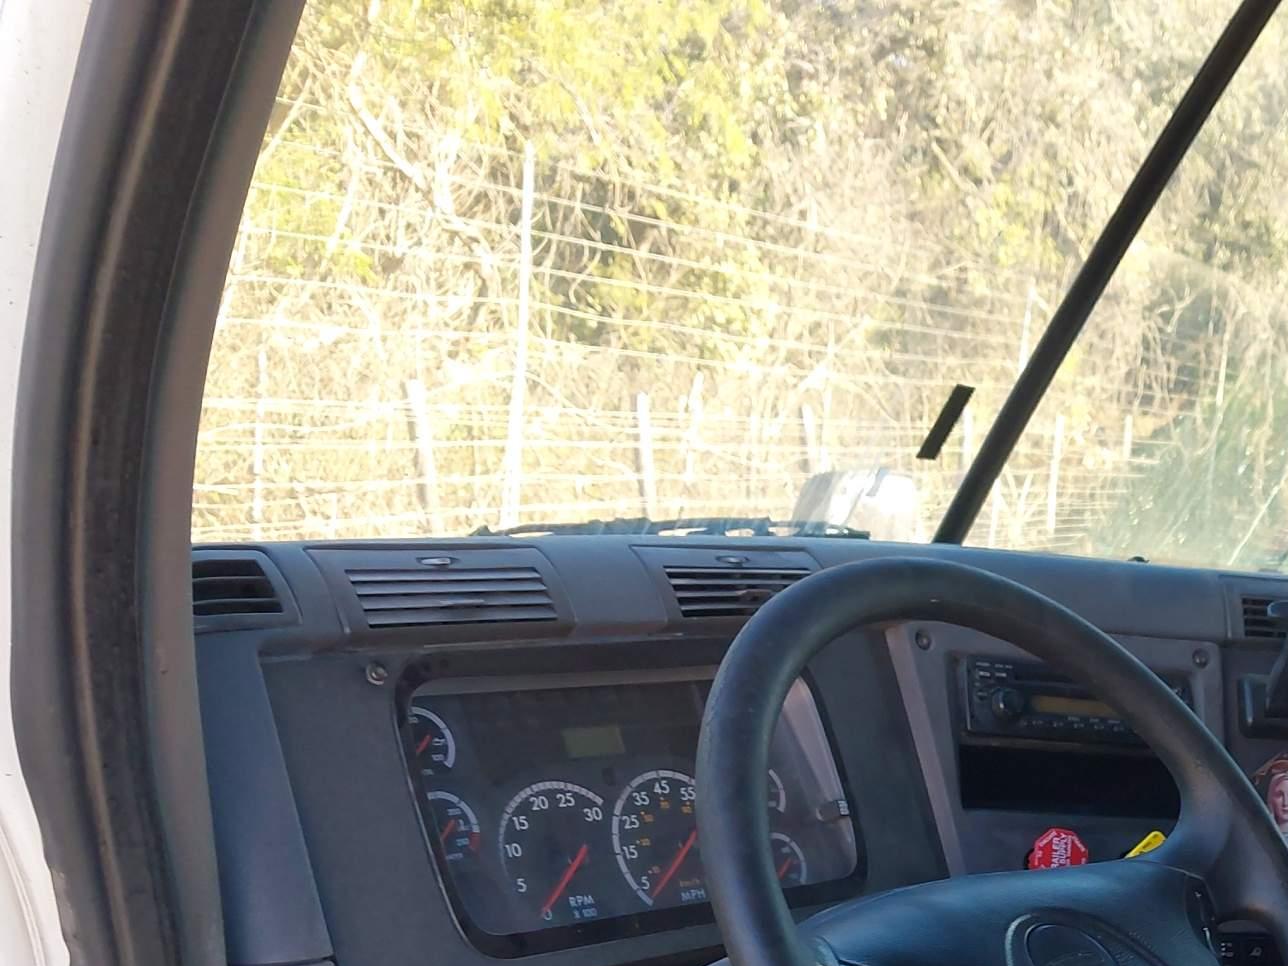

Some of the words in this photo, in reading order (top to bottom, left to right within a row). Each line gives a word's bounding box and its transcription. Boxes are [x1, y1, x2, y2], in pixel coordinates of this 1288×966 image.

[653, 781, 670, 794] 45
[680, 787, 696, 800] 55
[530, 796, 548, 810] 20
[556, 793, 575, 807] 25
[632, 792, 650, 805] 35
[583, 807, 602, 821] 30
[512, 816, 528, 830] 15
[622, 815, 640, 829] 25
[505, 843, 522, 858] 10
[622, 845, 638, 859] 15
[516, 878, 527, 892] 5
[640, 876, 650, 889] 5
[568, 895, 595, 907] RPM
[680, 889, 706, 901] MPH
